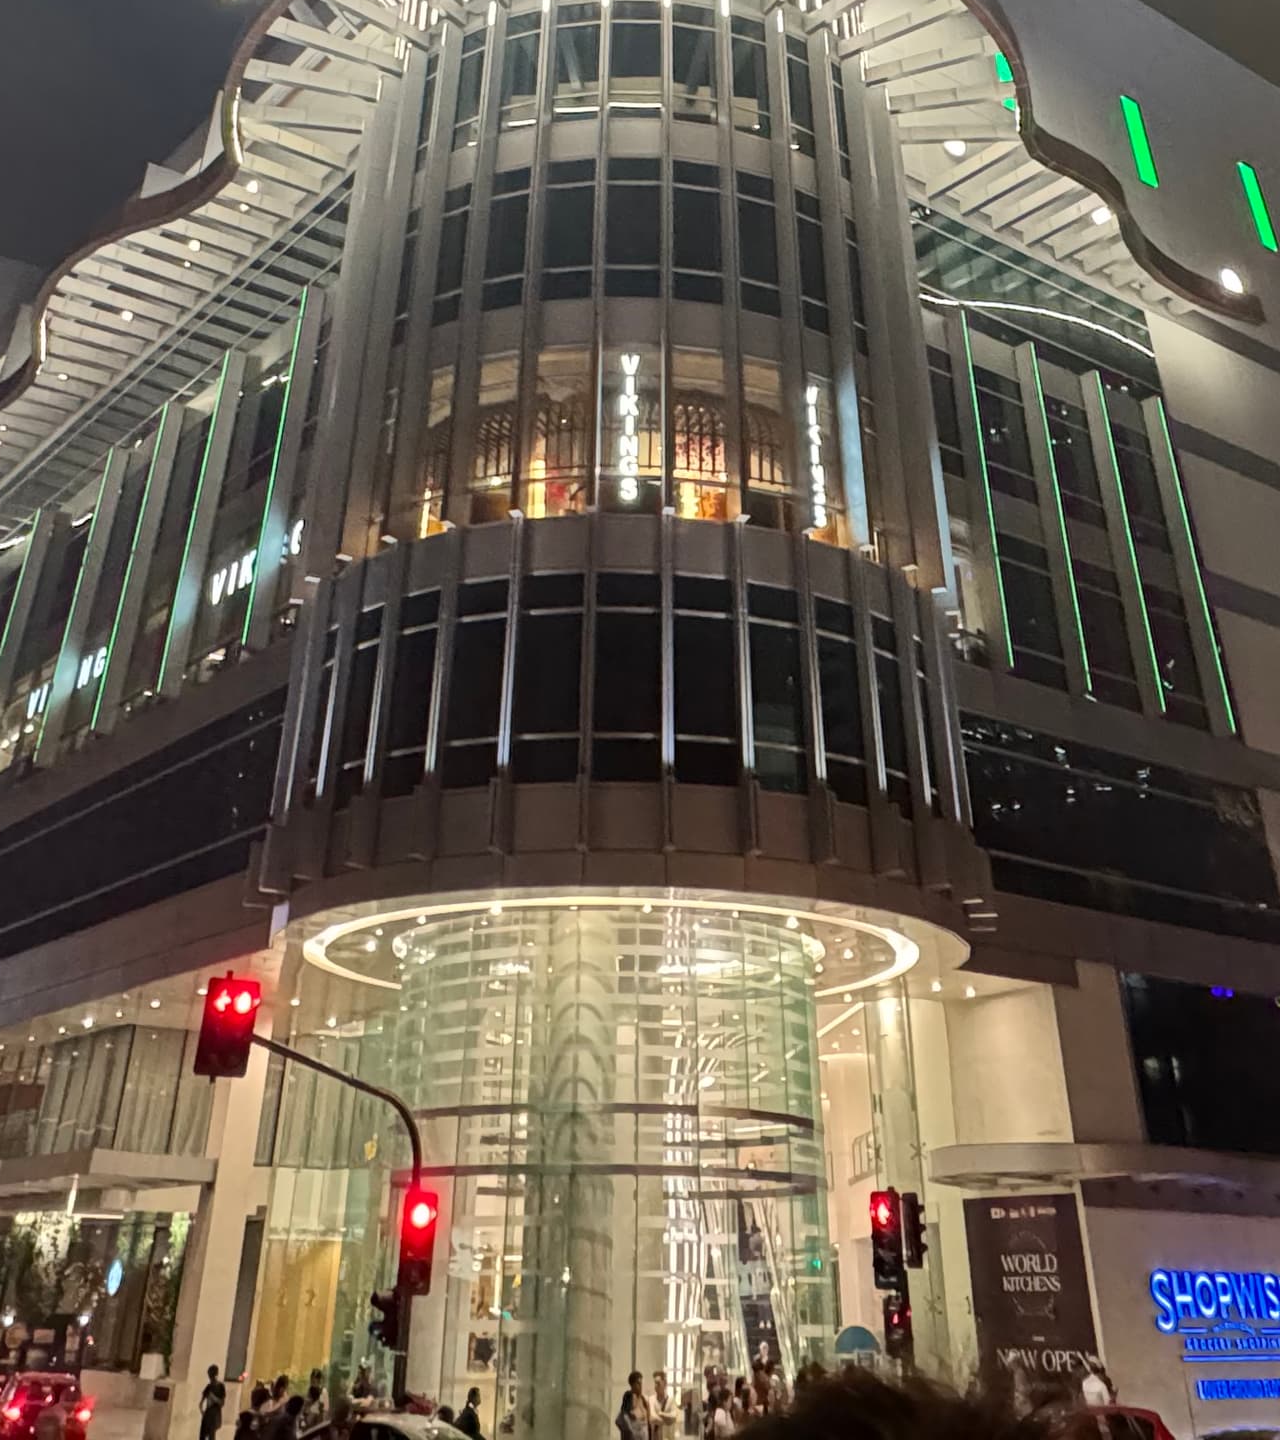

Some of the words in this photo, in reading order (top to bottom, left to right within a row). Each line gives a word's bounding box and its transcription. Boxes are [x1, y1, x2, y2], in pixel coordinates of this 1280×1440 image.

[620, 353, 641, 501] VIKINGS
[1001, 1253, 1059, 1274] WORLD
[1002, 1274, 1062, 1292] KITCHENS
